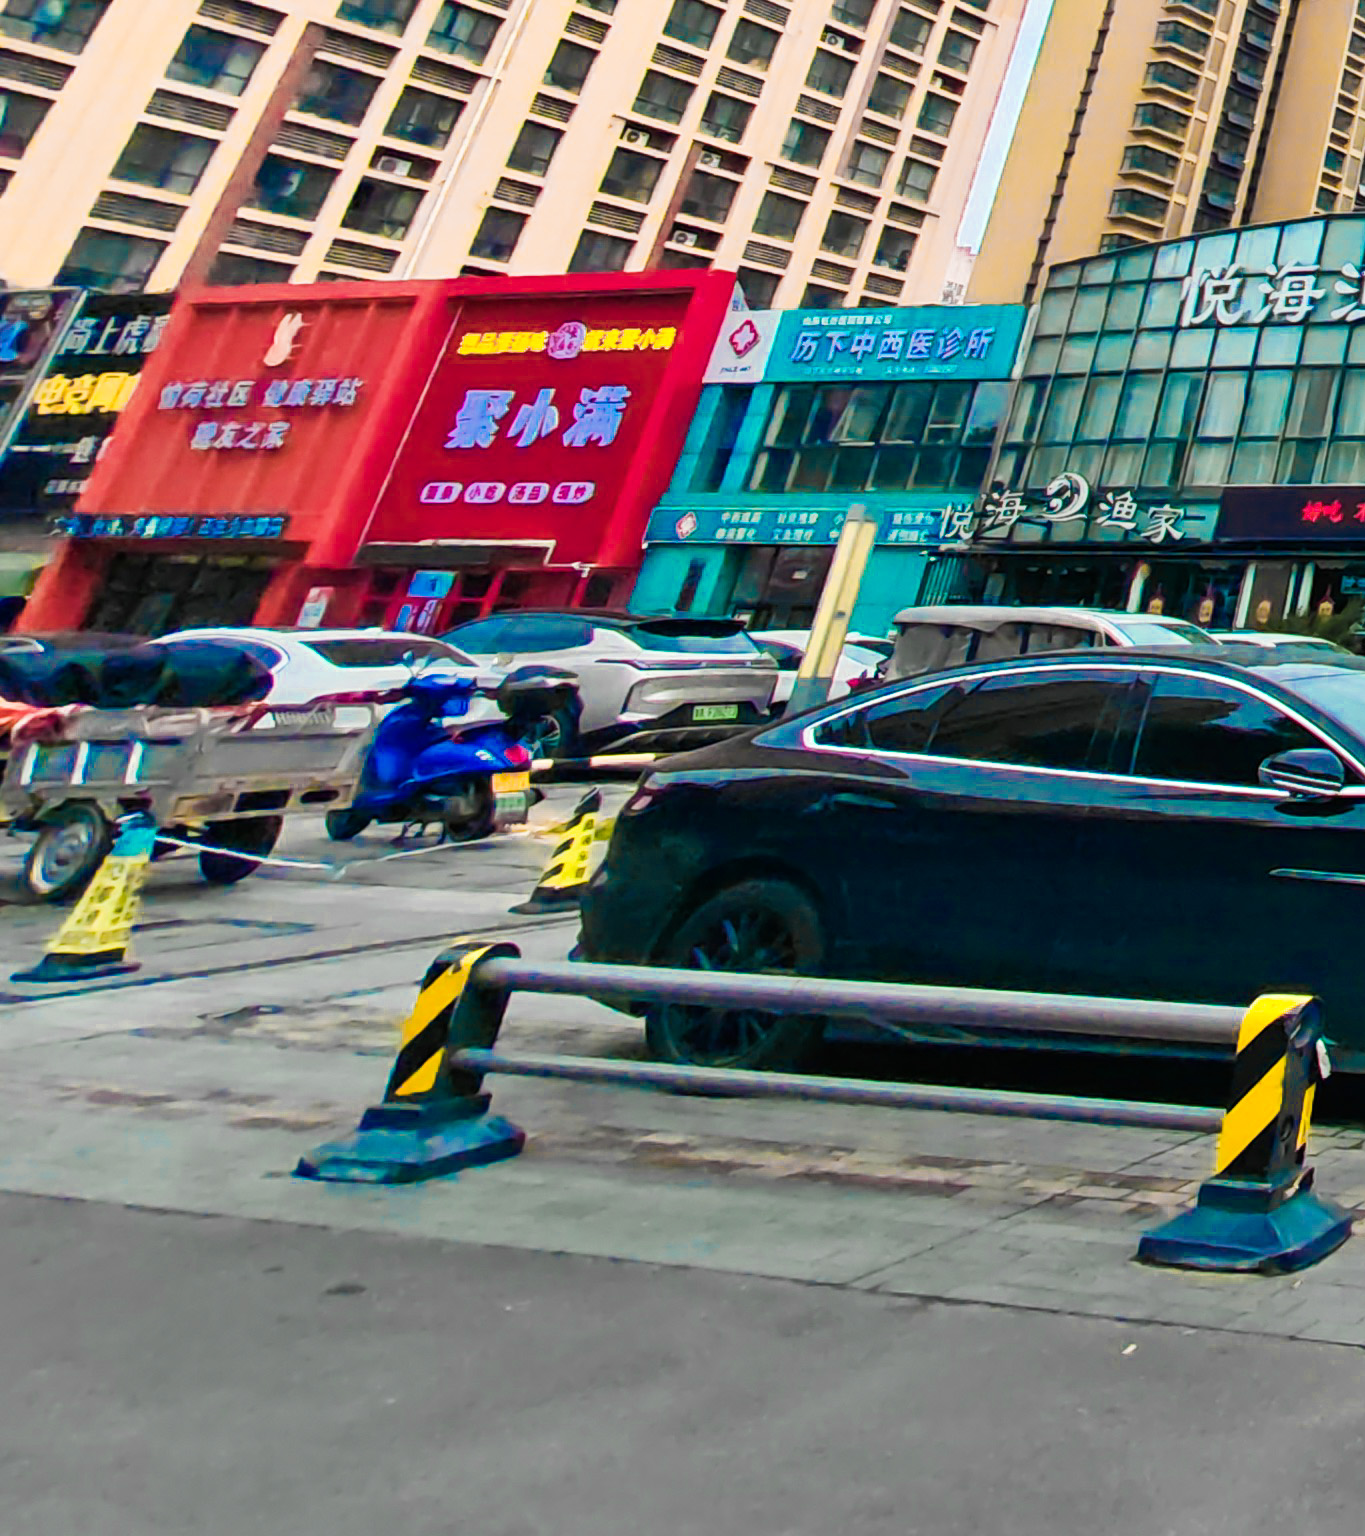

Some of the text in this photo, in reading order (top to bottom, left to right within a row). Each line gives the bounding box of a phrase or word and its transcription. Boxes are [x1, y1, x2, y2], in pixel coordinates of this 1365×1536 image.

[790, 326, 995, 362] 历下中西医诊所
[443, 385, 632, 449] 聚小满
